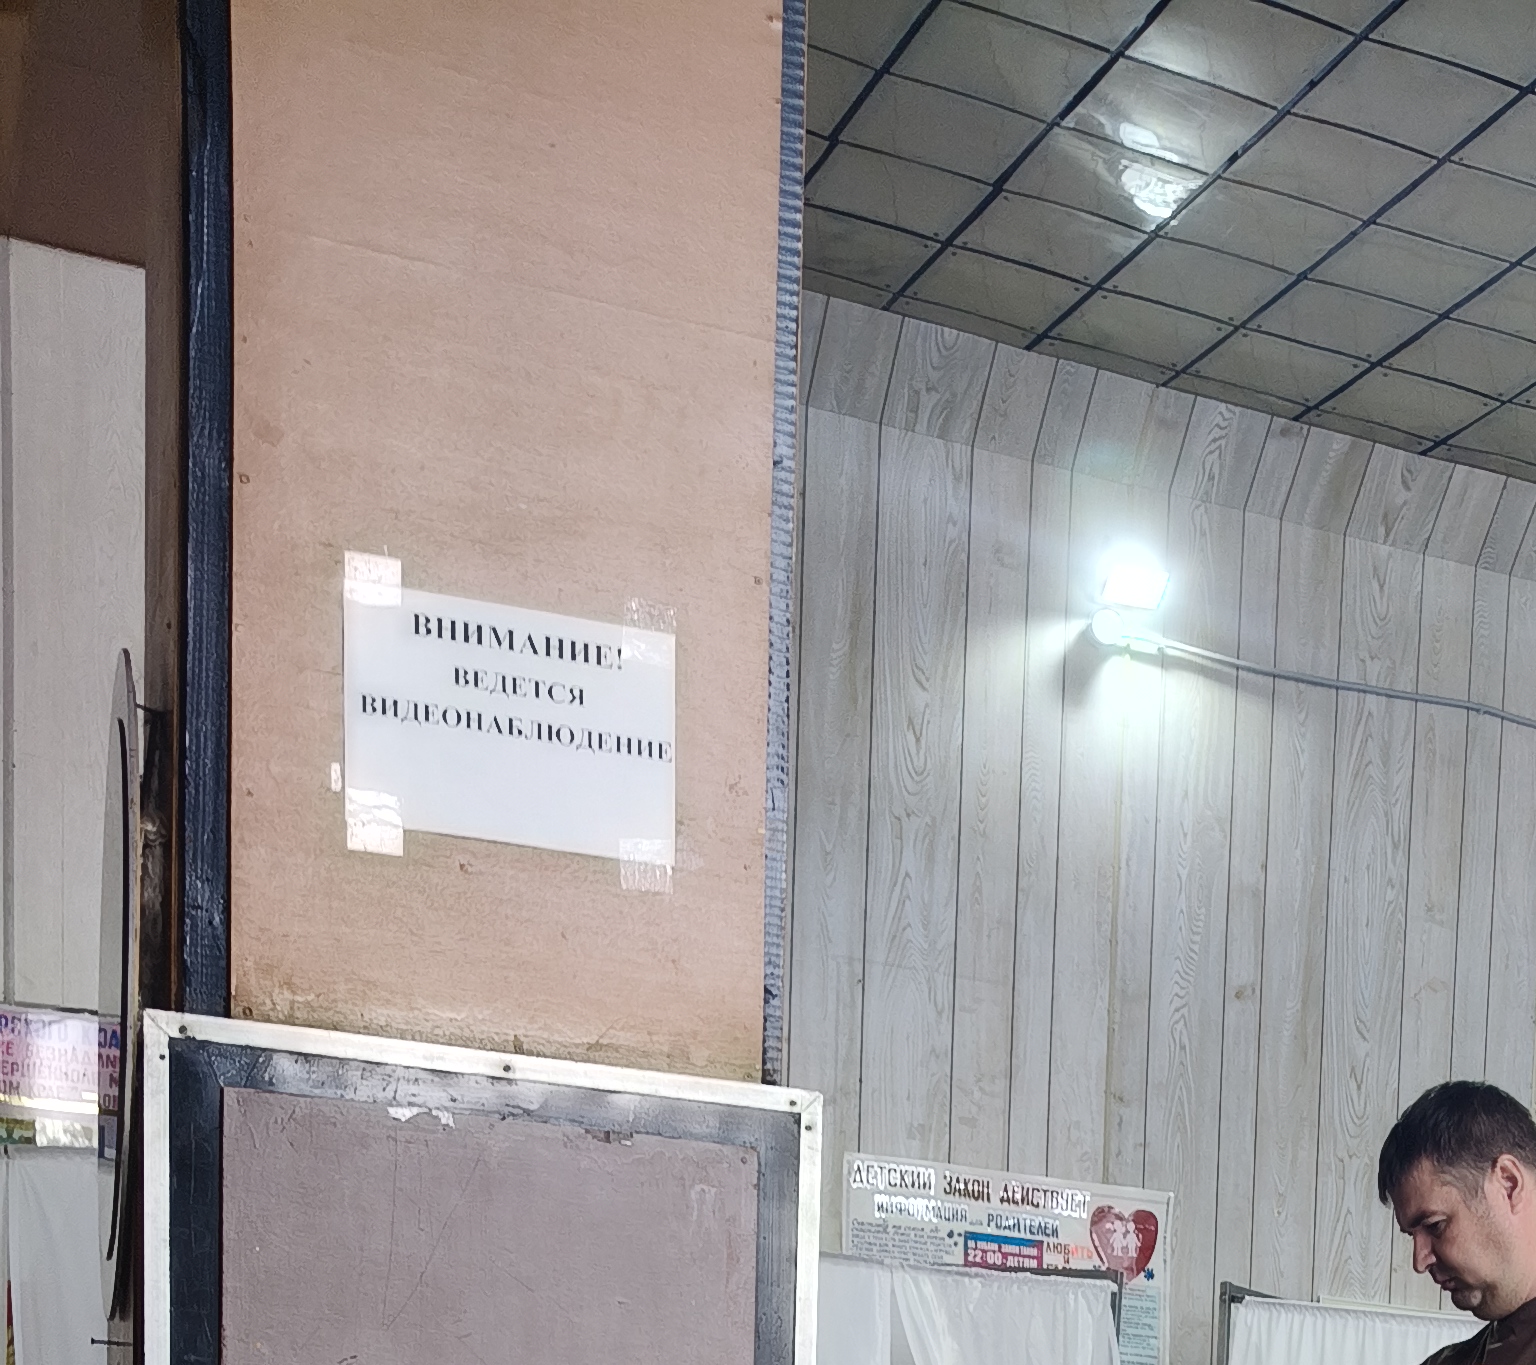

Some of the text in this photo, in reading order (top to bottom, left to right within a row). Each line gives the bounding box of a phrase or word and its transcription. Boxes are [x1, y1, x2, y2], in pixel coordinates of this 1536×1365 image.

[413, 612, 624, 670] ВНИМАНИЕ!
[454, 666, 586, 706] ВЕДЕТСЯ
[361, 693, 673, 763] ВИДЕОНАБЛЮДЕНИЕ
[944, 1173, 991, 1203] ЗАКОН
